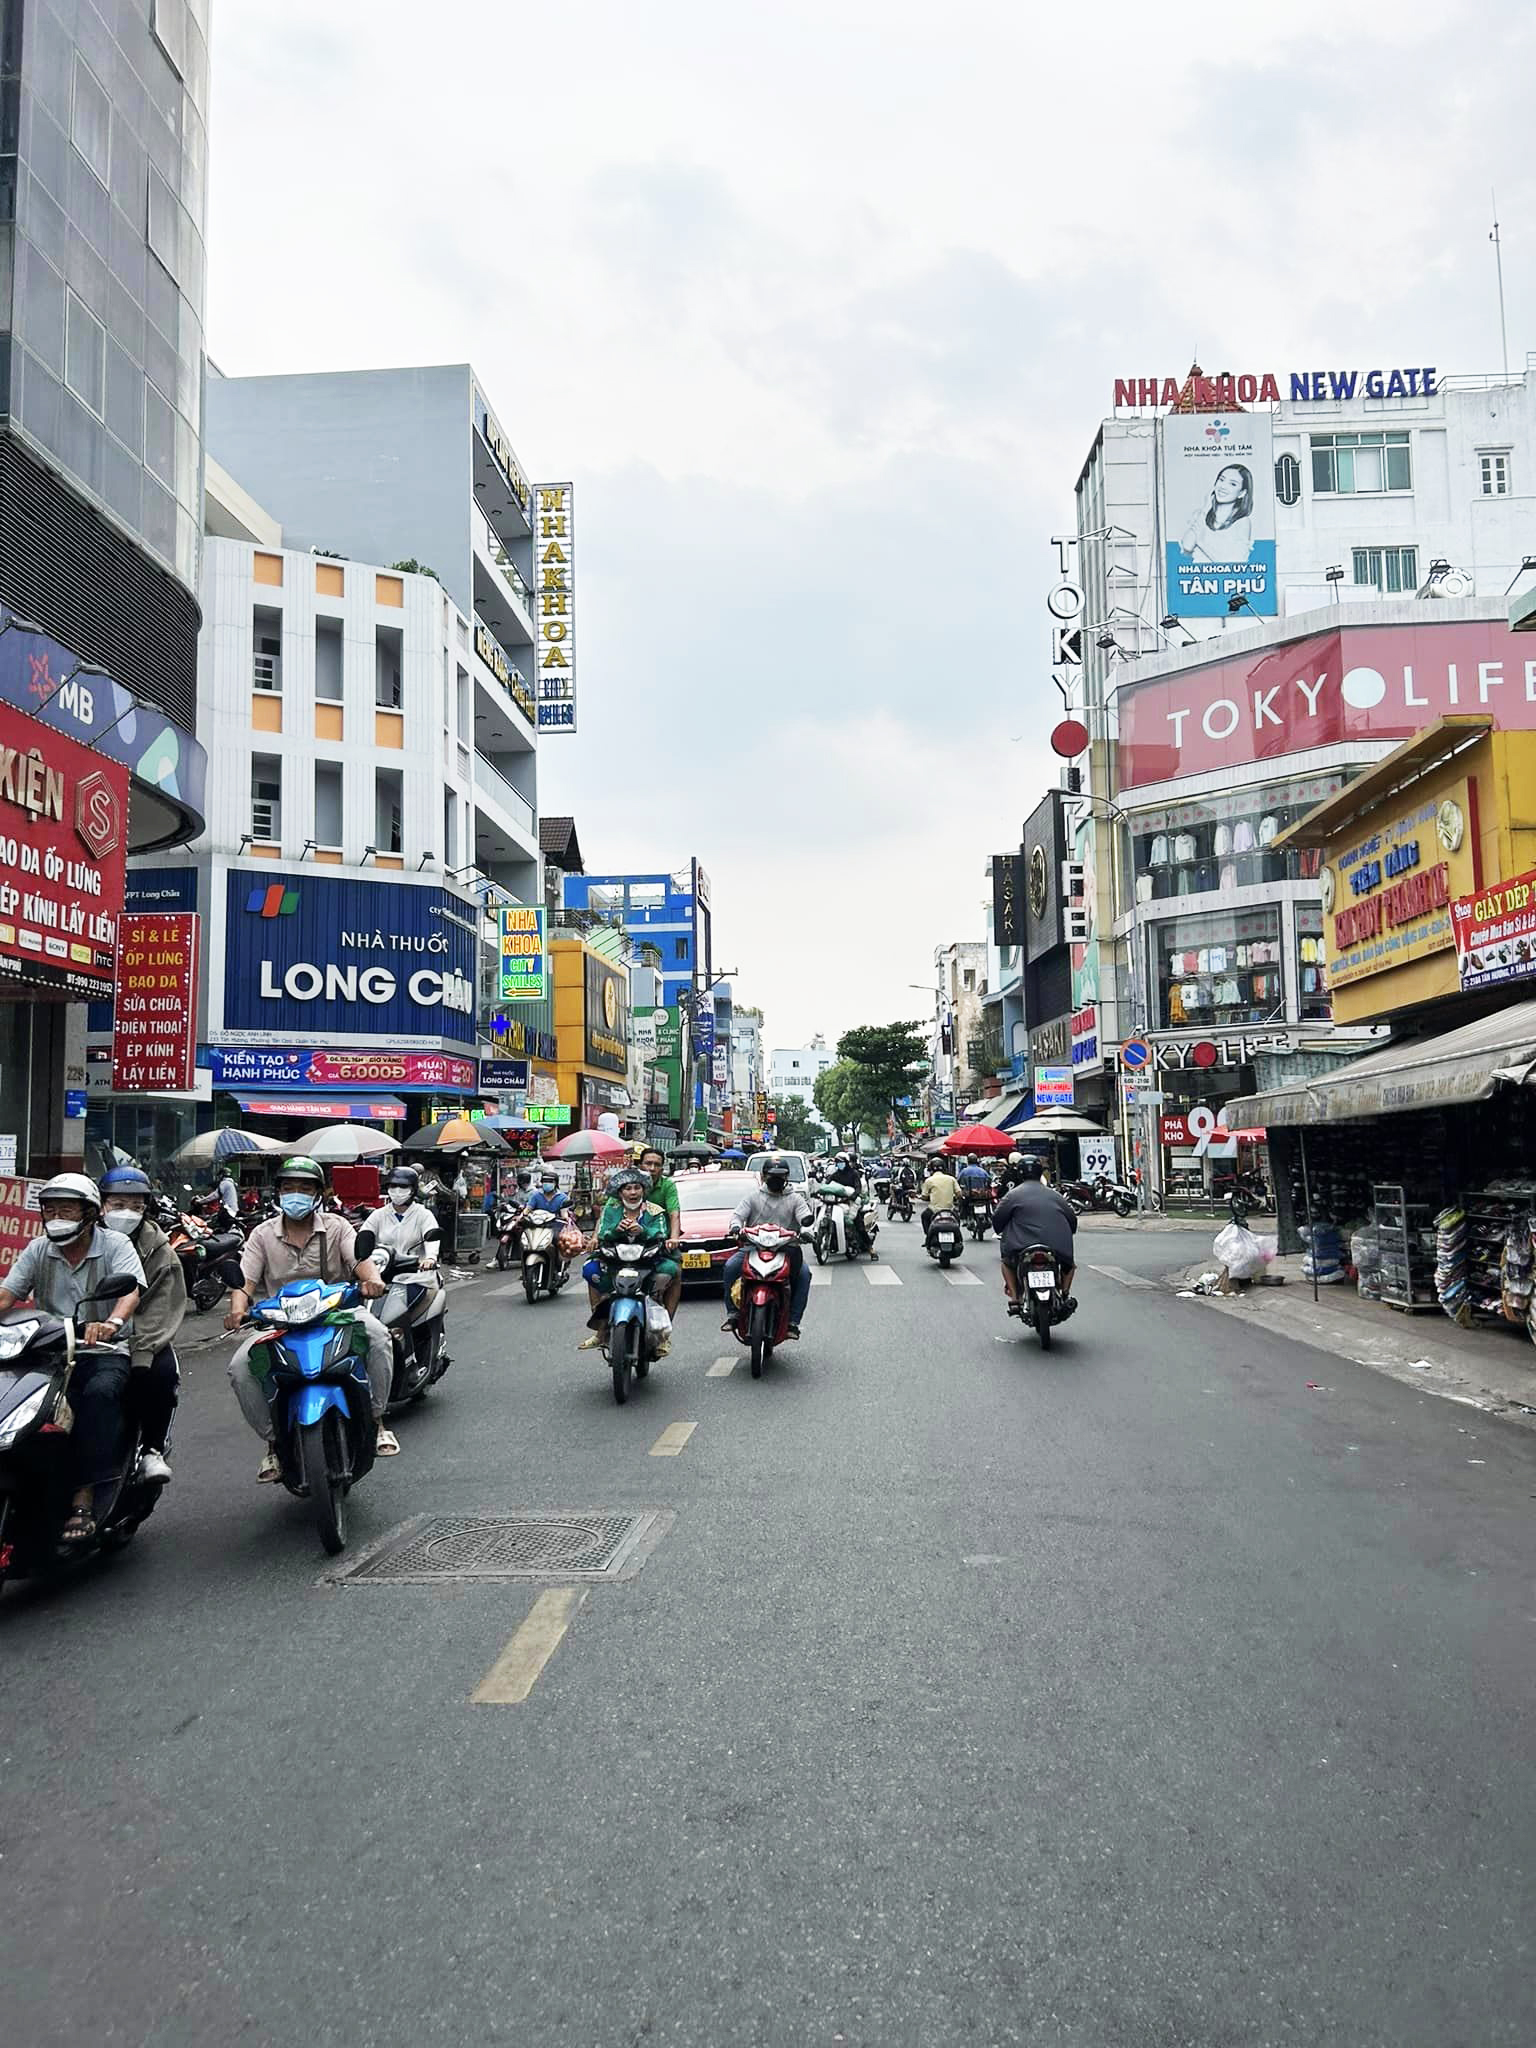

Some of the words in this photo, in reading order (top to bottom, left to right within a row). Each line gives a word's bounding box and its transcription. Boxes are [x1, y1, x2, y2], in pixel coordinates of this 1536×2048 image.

[1114, 378, 1179, 407] NHA
[1193, 373, 1281, 403] KHOA
[1290, 371, 1358, 400] NEW
[1366, 367, 1438, 398] GATE
[1178, 564, 1201, 574] NHA
[1203, 564, 1231, 574] KHOA
[1233, 564, 1248, 573] UY
[1250, 562, 1266, 573] TÍN
[1180, 577, 1218, 594] TÂN
[1223, 575, 1266, 593] PHÚ
[59, 675, 94, 725] MB
[1383, 840, 1420, 878] VÀNG
[21, 844, 40, 876] DA
[44, 846, 65, 883] ỐP
[67, 861, 101, 897] LƯNG
[141, 891, 160, 900] Long
[1474, 891, 1504, 922] GIÀY
[1505, 881, 1530, 912] DÉP
[23, 890, 58, 928] KÍNH
[61, 900, 86, 936] LẤY
[89, 909, 116, 945] LIỀN
[506, 910, 538, 931] NHA
[149, 929, 159, 943] &
[342, 929, 385, 949] NHÀ
[502, 934, 542, 956] KHOA
[125, 947, 144, 966] ỐP
[149, 949, 183, 966] LƯNG
[510, 958, 534, 973] CITY
[129, 975, 156, 988] BAO
[159, 975, 178, 988] DA
[260, 960, 397, 1004] LONG
[502, 974, 543, 989] SMILES
[123, 993, 146, 1011] SỬA
[150, 995, 182, 1011] CHỮA
[121, 1018, 147, 1037] ĐIỆN
[150, 1020, 182, 1037] THOẠI
[126, 1039, 143, 1057] ÉP
[146, 1040, 174, 1057] KÍNH
[224, 1049, 255, 1066] KIẾN
[258, 1055, 285, 1068] TẠO
[122, 1062, 145, 1080] LẤY
[149, 1061, 176, 1080] LIỀN
[223, 1067, 260, 1081] HẠNH
[263, 1066, 300, 1080] PHÚC
[340, 1065, 406, 1079] 6.000Đ
[483, 1077, 503, 1085] LONG
[504, 1076, 525, 1085] CHÂU
[1037, 1094, 1053, 1103] NEW
[1055, 1094, 1072, 1103] GATE
[1165, 1131, 1184, 1141] KHO
